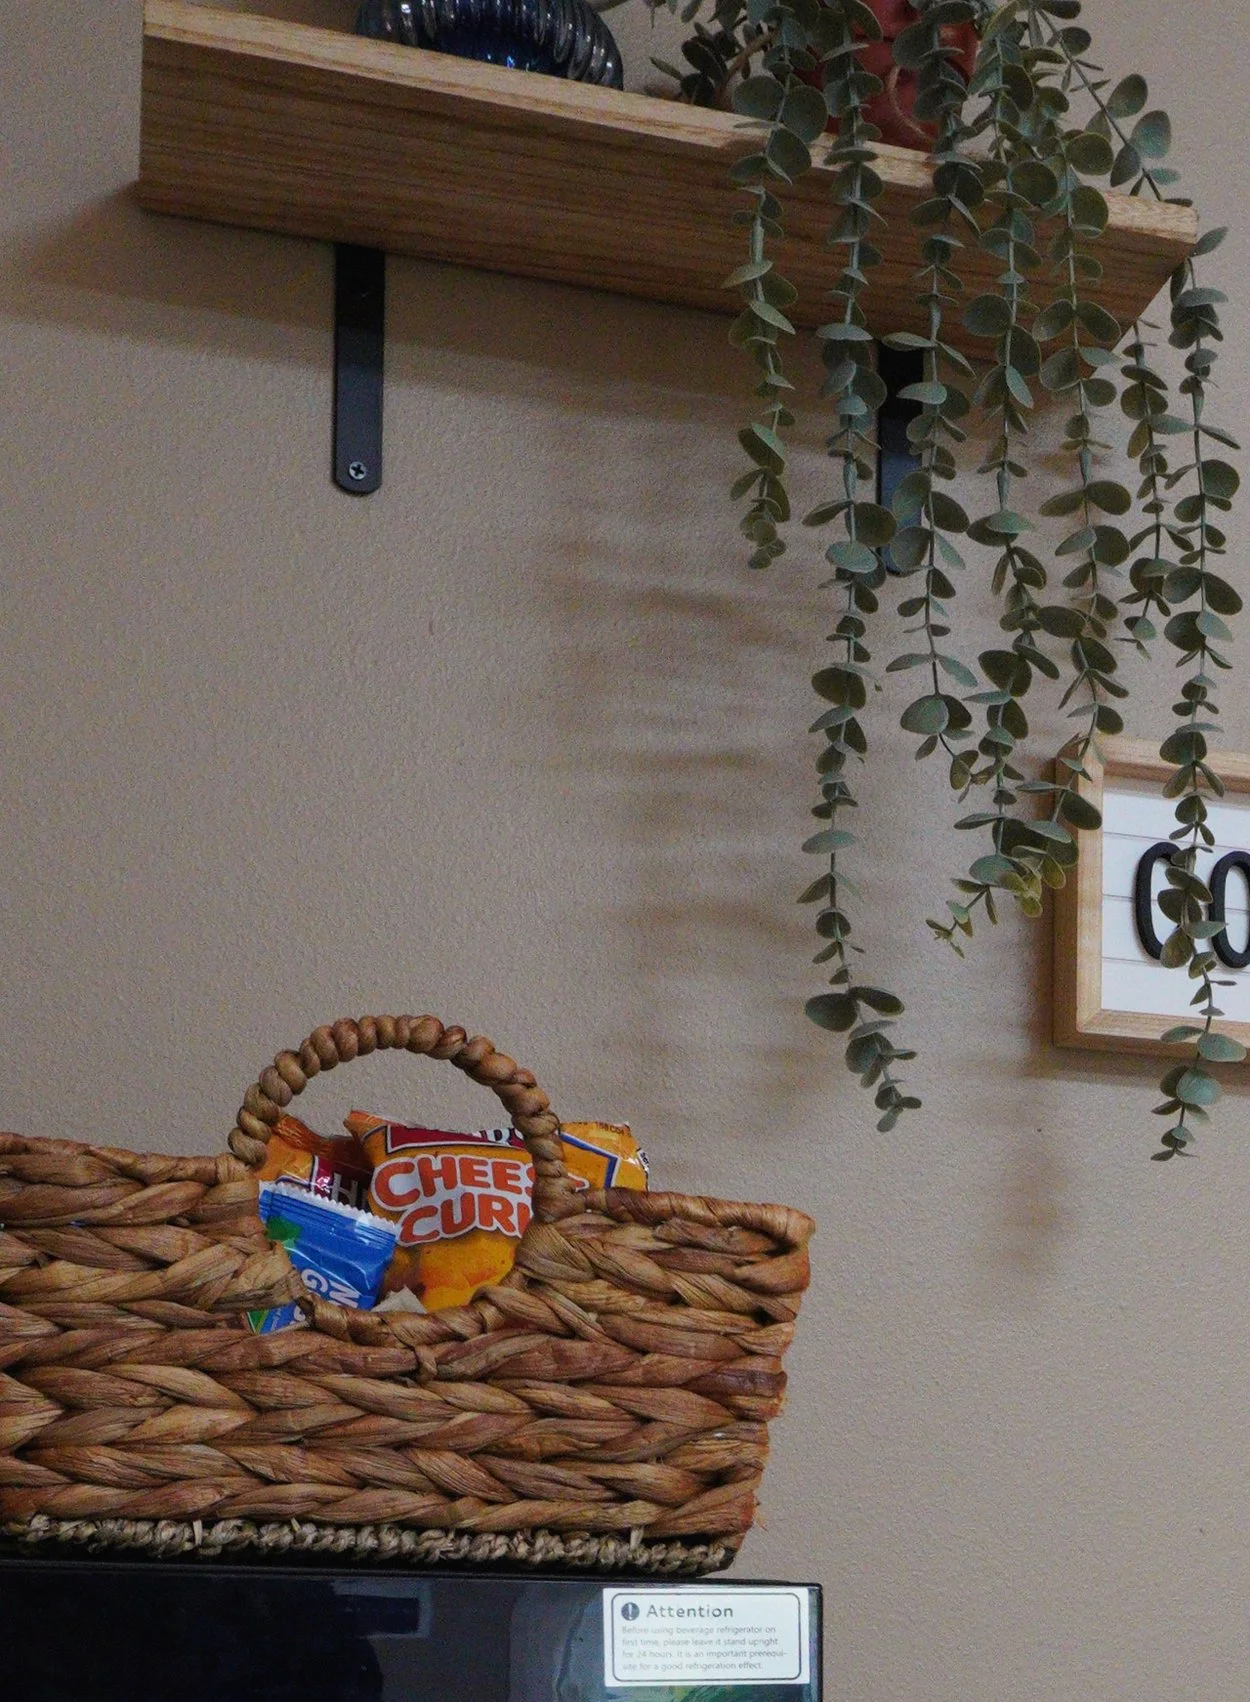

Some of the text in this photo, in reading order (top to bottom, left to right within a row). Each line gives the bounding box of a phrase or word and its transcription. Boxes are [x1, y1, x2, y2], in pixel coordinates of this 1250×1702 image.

[647, 1604, 734, 1618] Attention
[622, 1626, 649, 1635] Before
[651, 1626, 673, 1636] using
[676, 1625, 714, 1636] beverage
[716, 1625, 762, 1636] refrigerator
[622, 1638, 640, 1646] first
[641, 1638, 661, 1647] time,
[663, 1637, 690, 1648] please
[691, 1637, 714, 1646] leave
[723, 1637, 746, 1646] stand
[748, 1637, 778, 1648] upright
[622, 1650, 634, 1658] for
[636, 1650, 647, 1658] 24
[706, 1649, 747, 1660] important
[749, 1649, 787, 1660] prerequi-
[622, 1662, 637, 1670] site
[639, 1661, 651, 1670] for
[661, 1661, 682, 1672] good
[685, 1661, 737, 1672] refrigeration
[738, 1661, 762, 1670] effect.
